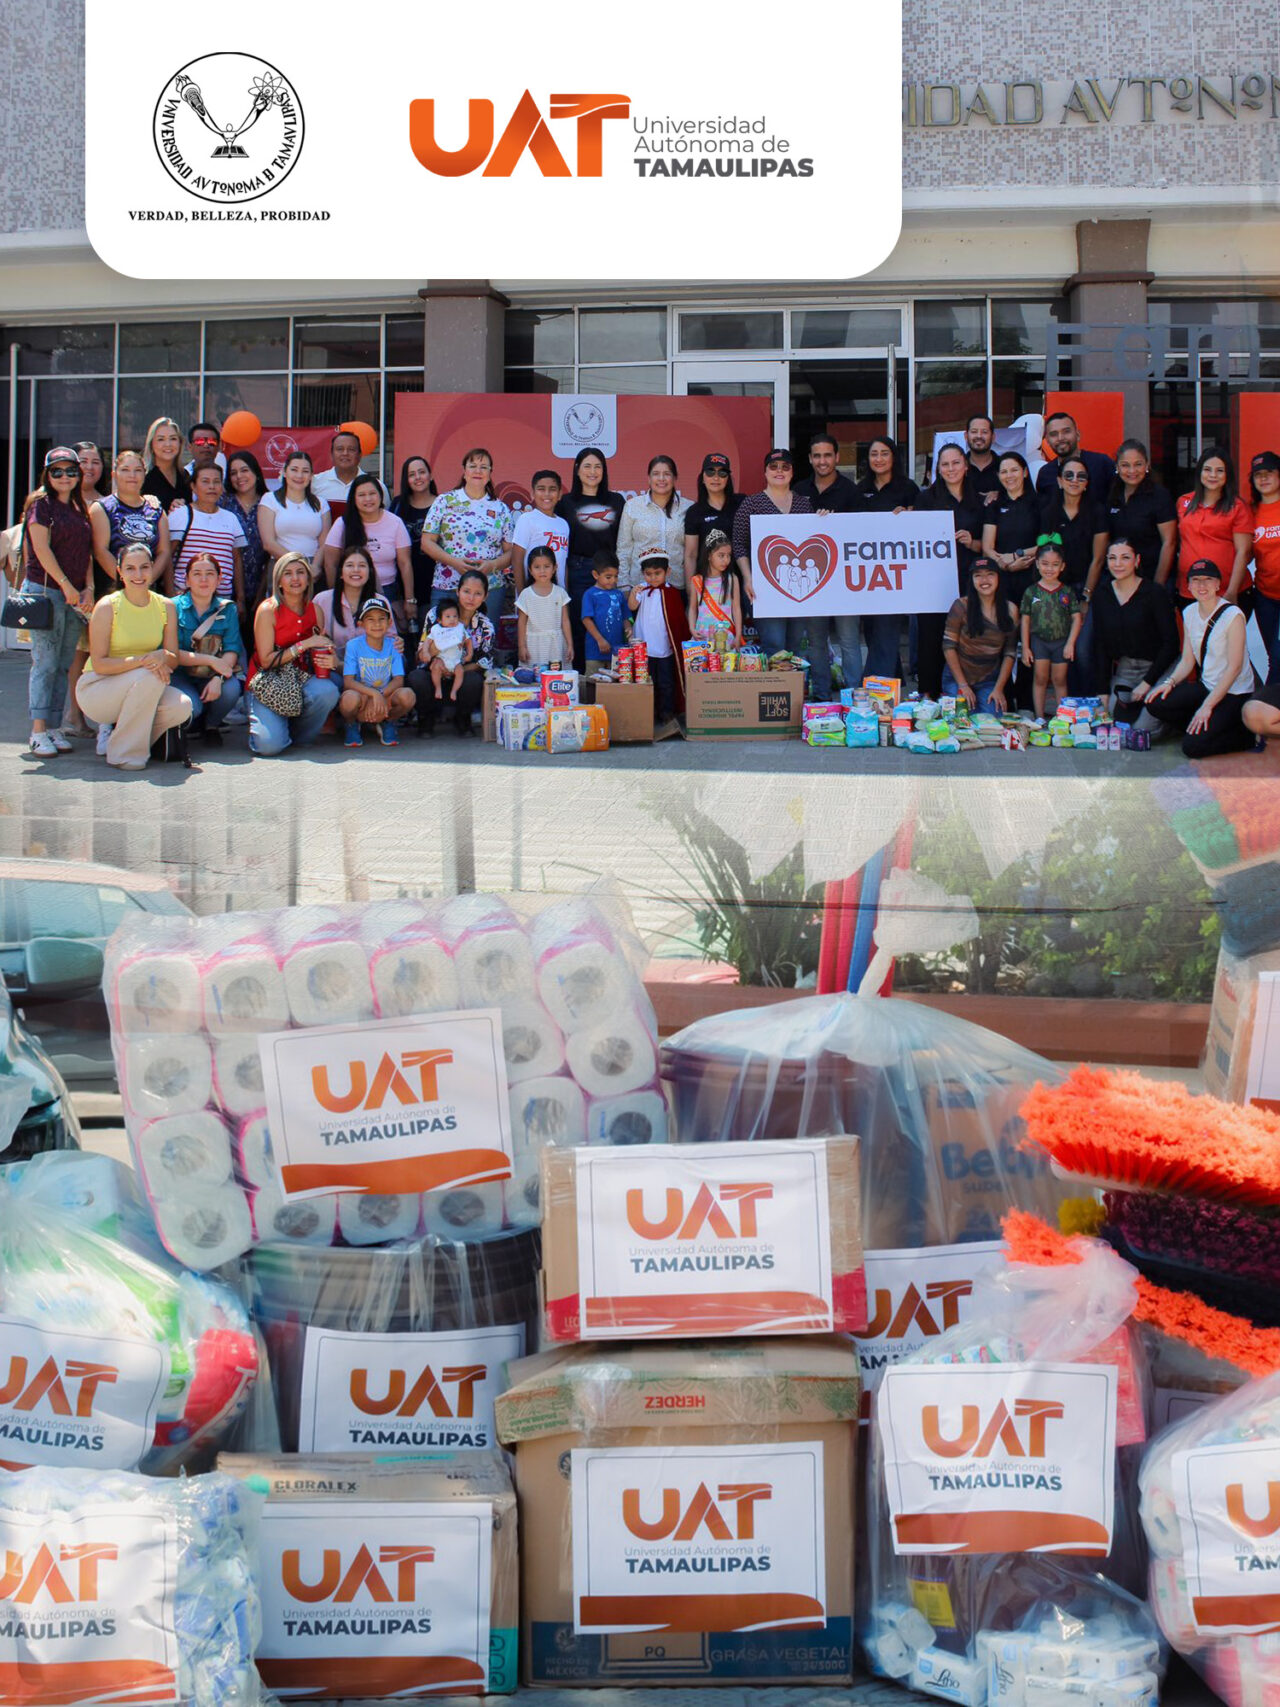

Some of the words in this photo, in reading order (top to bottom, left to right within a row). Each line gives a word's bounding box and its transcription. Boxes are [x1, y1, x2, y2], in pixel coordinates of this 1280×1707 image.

[843, 540, 952, 561] Familia
[844, 564, 907, 592] UAT
[551, 682, 572, 691] Elite
[311, 1048, 453, 1113] UAT
[442, 1105, 456, 1115] de
[320, 1115, 458, 1146] TAMAULIPAS
[626, 1181, 774, 1240] UAT
[760, 1243, 774, 1253] de
[630, 1254, 774, 1273] TAMAULIPAS
[350, 1364, 487, 1418] UAT
[644, 1395, 705, 1408] HERDEZ
[93, 1424, 106, 1433] de
[474, 1423, 487, 1431] de
[922, 1397, 1065, 1458] UAT
[0, 1426, 104, 1450] MAULIPAS
[349, 1430, 487, 1447] TAMAULIPAS
[274, 1480, 357, 1491] CLORALEX
[928, 1471, 1063, 1492] TAMAULIPAS
[622, 1481, 773, 1541] UAT
[757, 1544, 771, 1554] de
[282, 1542, 436, 1603] UAT
[625, 1556, 772, 1574] TAMAULIPAS
[101, 1608, 116, 1617] de
[417, 1606, 432, 1616] de
[0, 1619, 116, 1640] MAULIPAS
[284, 1619, 432, 1636] TAMAULIPAS
[711, 1648, 769, 1663] GRASA
[774, 1646, 849, 1661] VEGETAL
